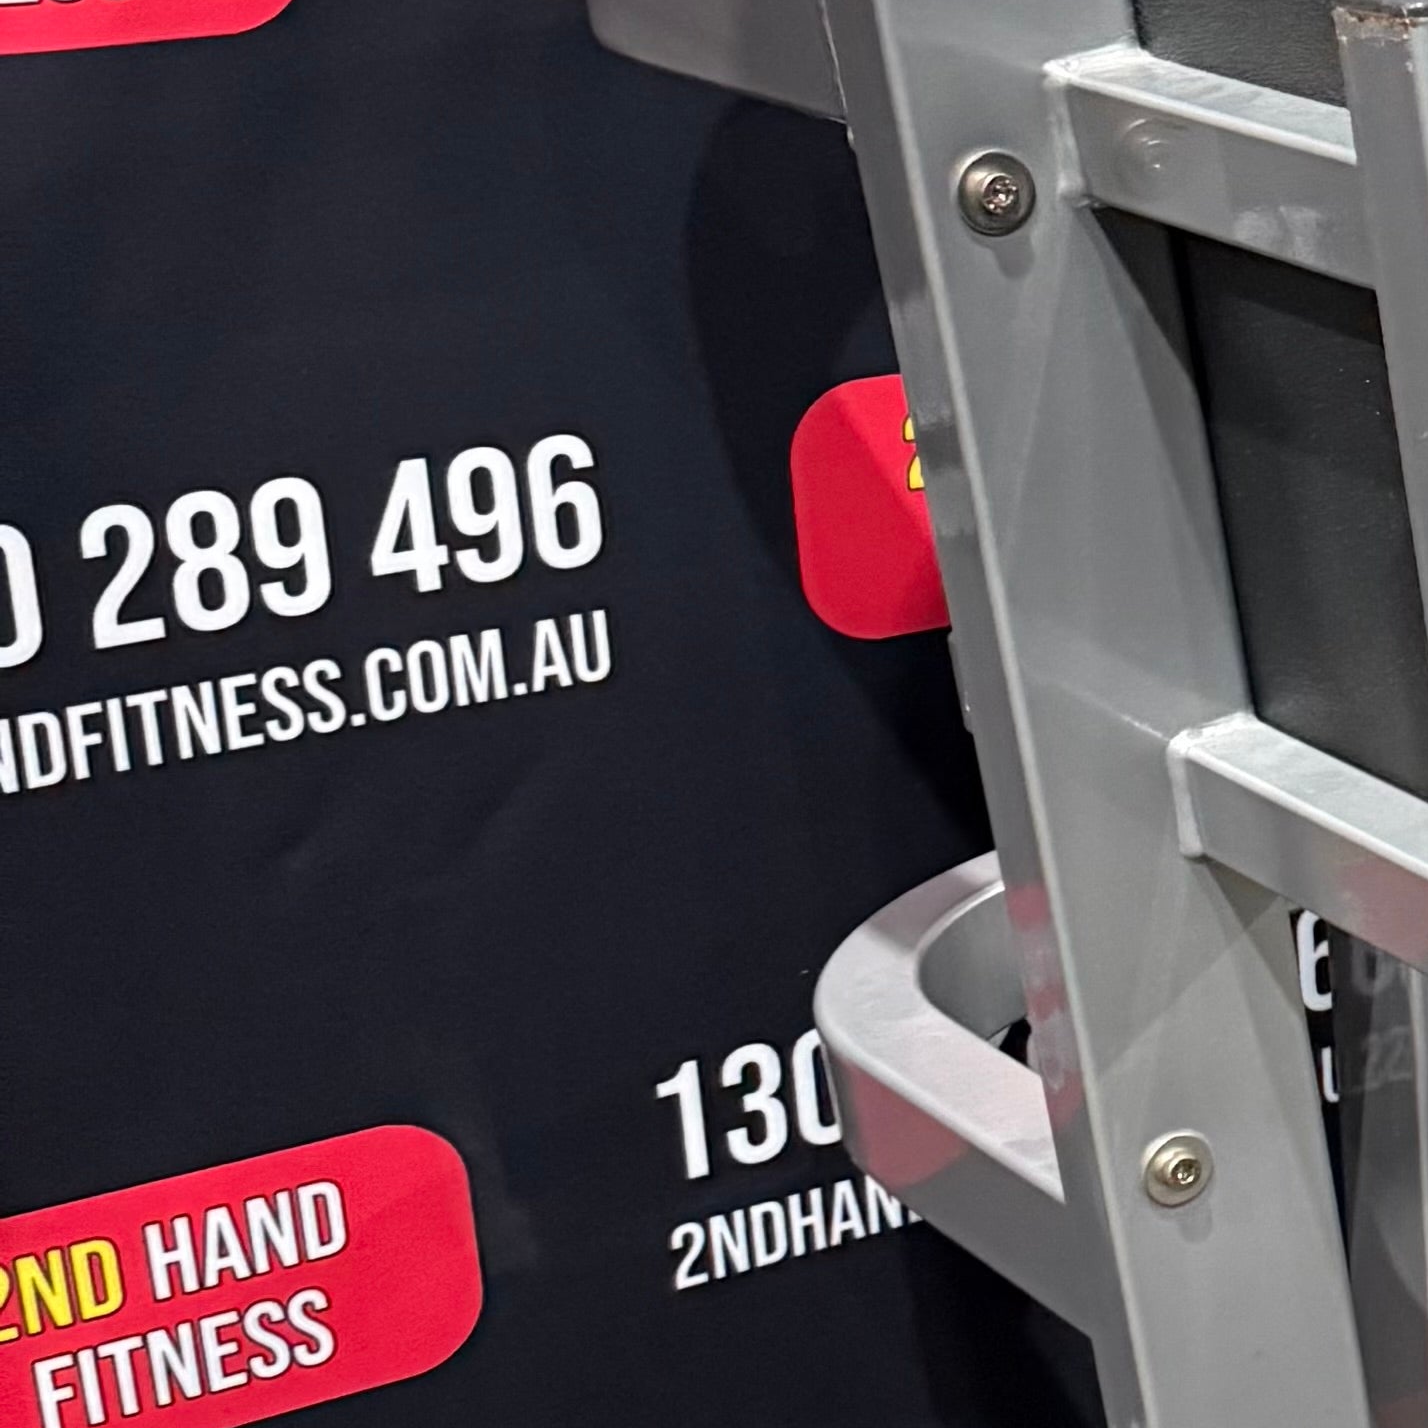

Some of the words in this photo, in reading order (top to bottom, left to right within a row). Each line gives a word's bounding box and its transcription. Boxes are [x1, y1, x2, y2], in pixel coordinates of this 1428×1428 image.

[79, 476, 333, 650] 289
[370, 433, 603, 593] 496
[143, 1180, 348, 1301] HAND
[669, 1174, 923, 1291] 2NDHAN
